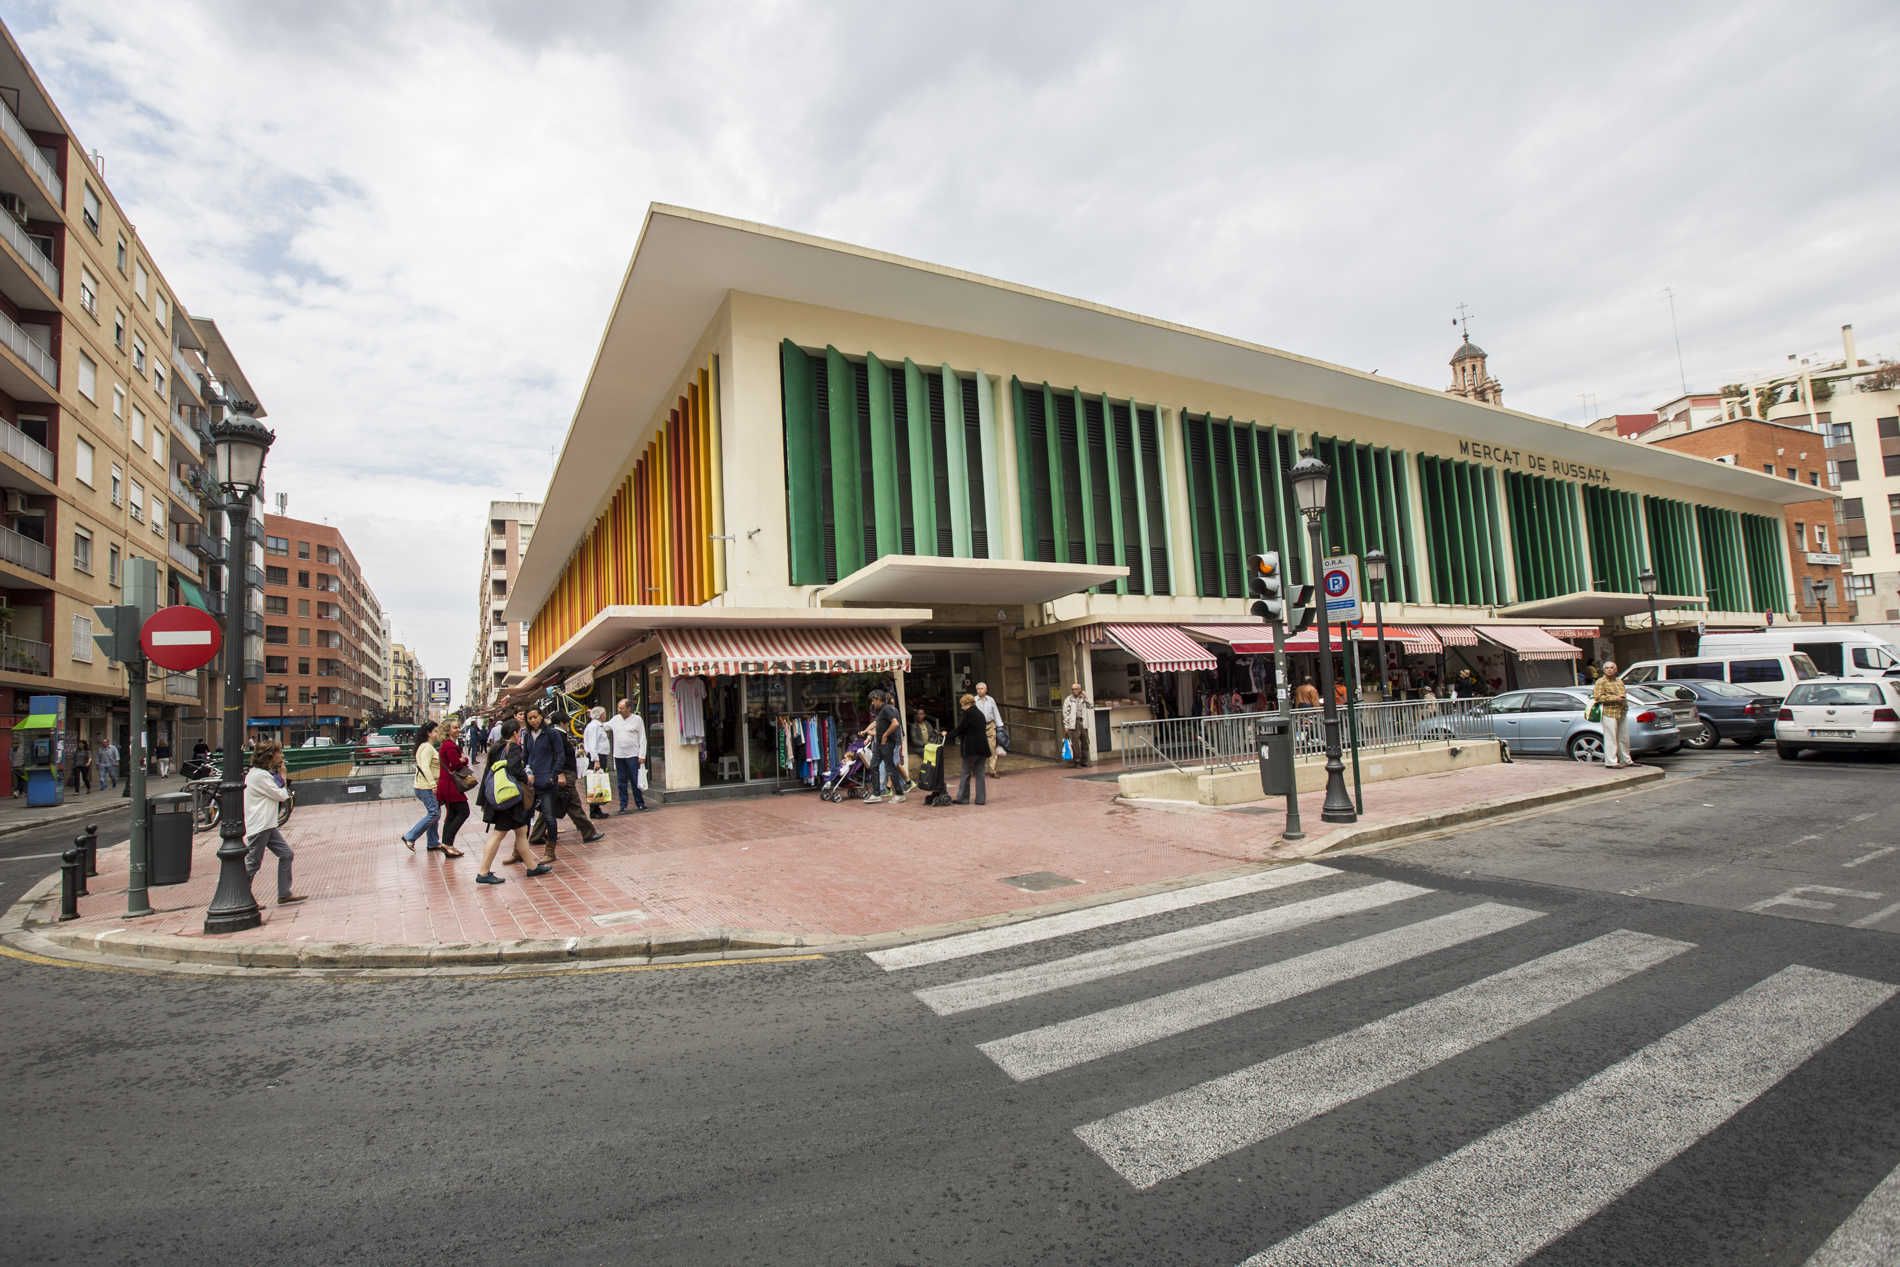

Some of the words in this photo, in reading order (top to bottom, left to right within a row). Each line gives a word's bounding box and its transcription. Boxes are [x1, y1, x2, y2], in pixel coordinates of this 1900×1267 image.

[1459, 439, 1520, 466] MERCAT
[1528, 454, 1546, 472] DE
[1552, 459, 1611, 485] RUSSAFA
[681, 663, 720, 673] MODA
[741, 660, 854, 673] DABIA
